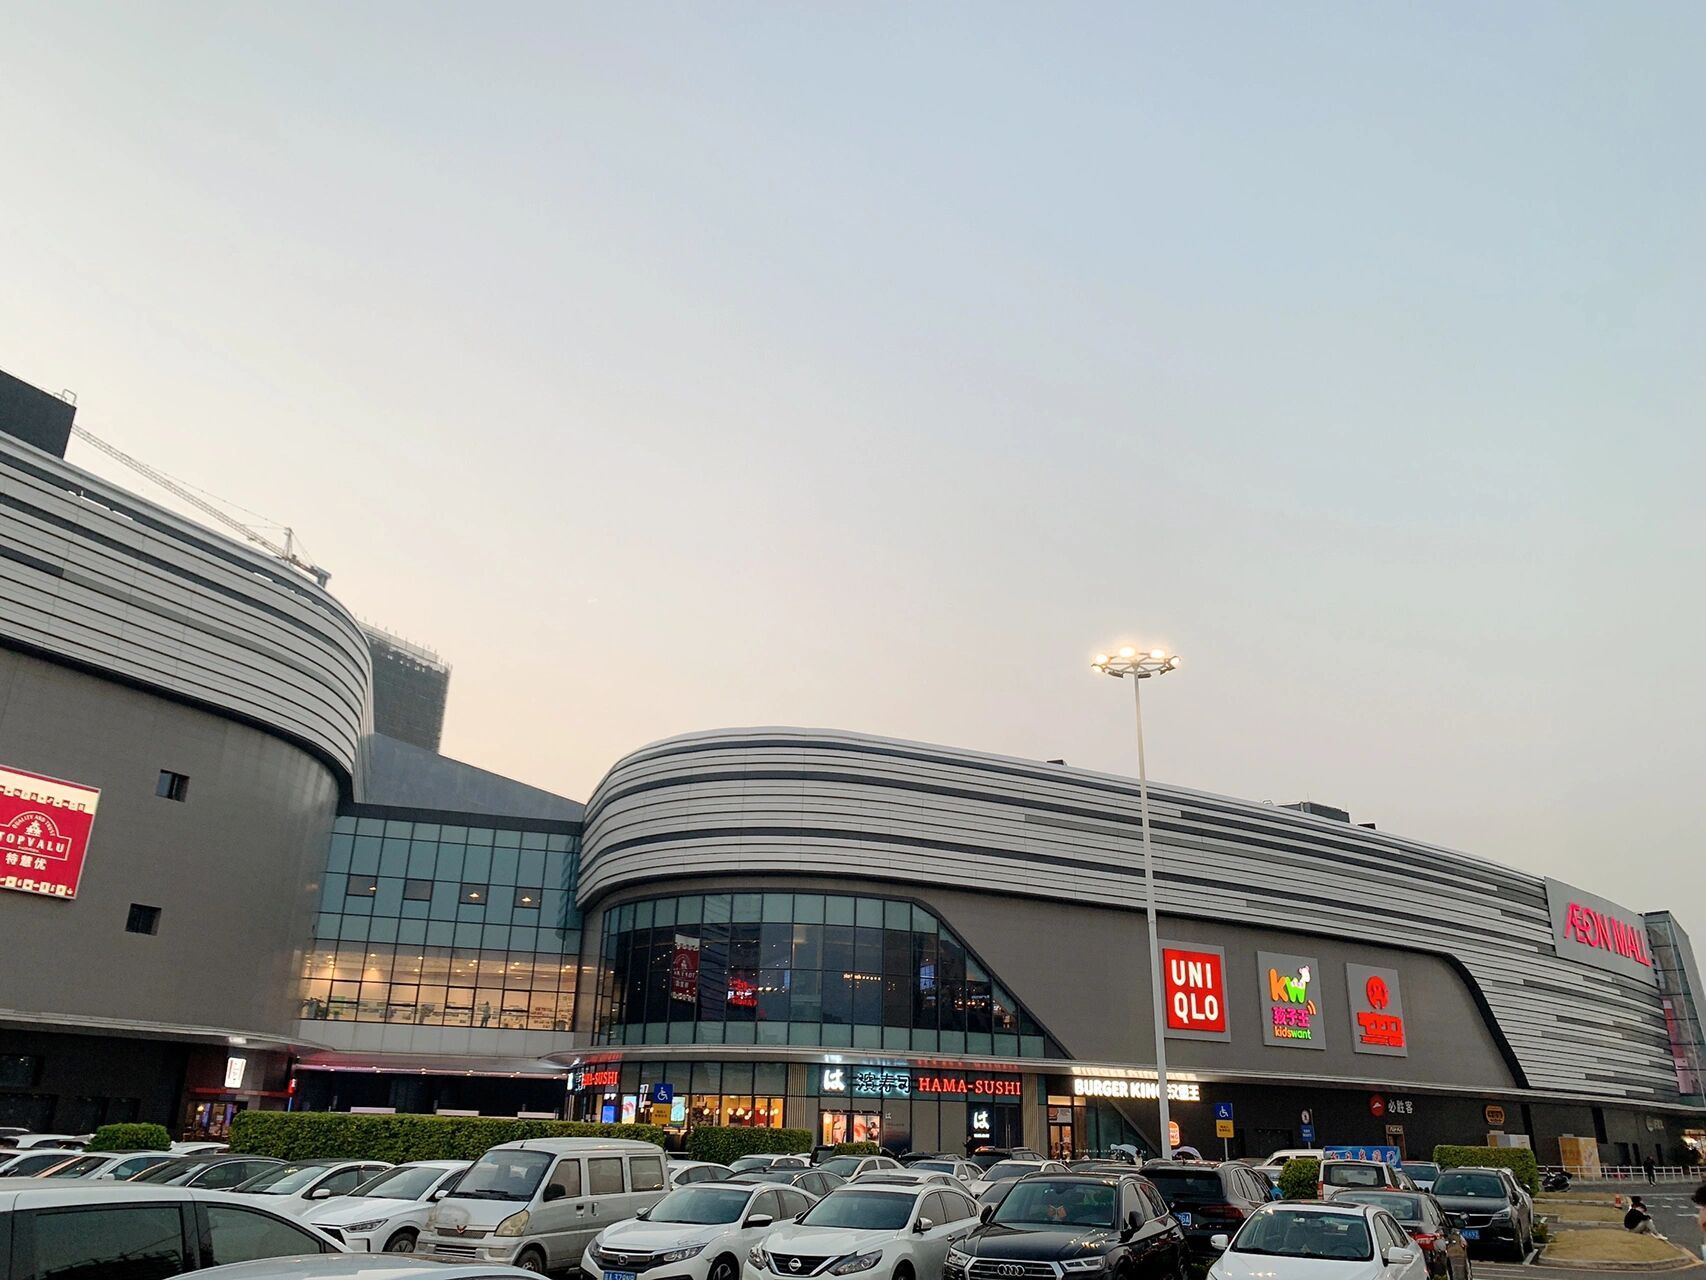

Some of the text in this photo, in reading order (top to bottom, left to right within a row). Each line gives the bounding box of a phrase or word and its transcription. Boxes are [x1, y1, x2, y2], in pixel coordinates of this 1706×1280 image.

[1611, 916, 1652, 968] MALL
[1171, 959, 1212, 989] UNI
[1174, 991, 1219, 1024] QLO
[1272, 1007, 1310, 1028] 孩子王
[1274, 1026, 1312, 1040] kidswant
[823, 1069, 845, 1091] は
[918, 1077, 1022, 1095] HAMA-SUSHI
[1074, 1079, 1129, 1098] BURGER
[973, 1111, 990, 1130] は
